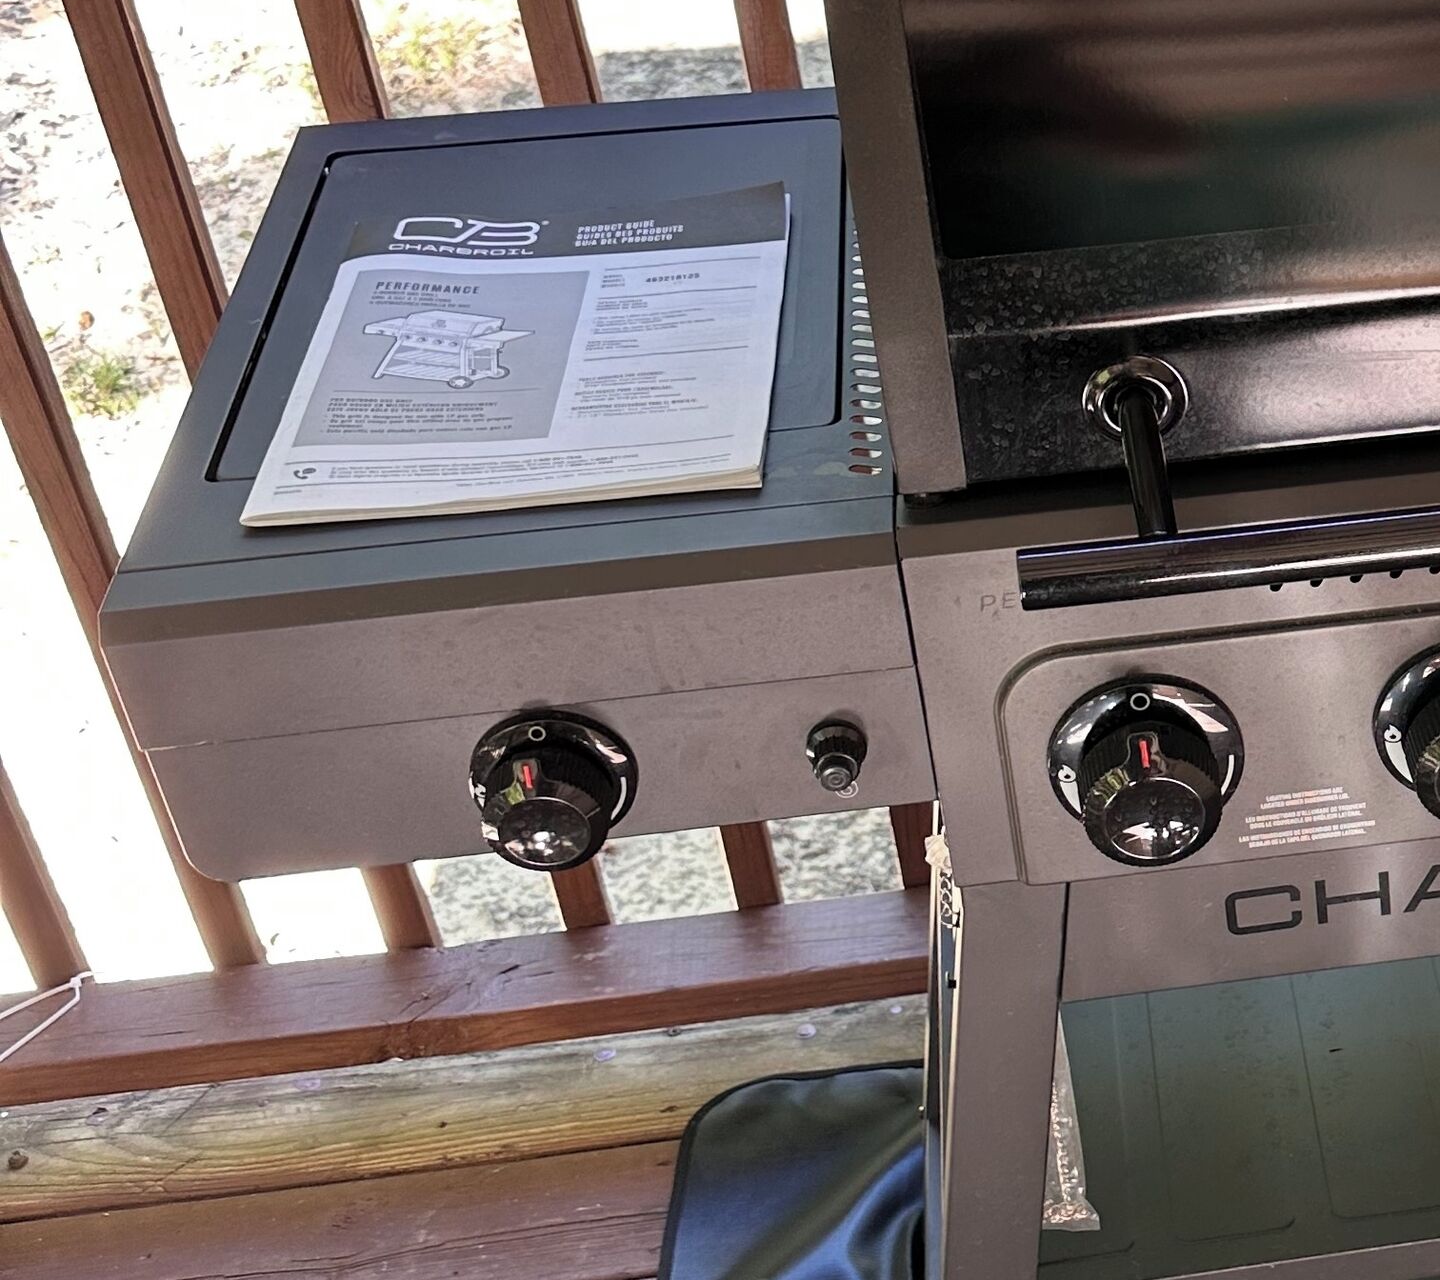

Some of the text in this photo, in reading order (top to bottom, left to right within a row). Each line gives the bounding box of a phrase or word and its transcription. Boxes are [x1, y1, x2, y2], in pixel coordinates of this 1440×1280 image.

[578, 220, 655, 233] PRODUCT GUIDE
[388, 243, 534, 256] CHARBROIL
[375, 281, 481, 294] PERFORMANCE
